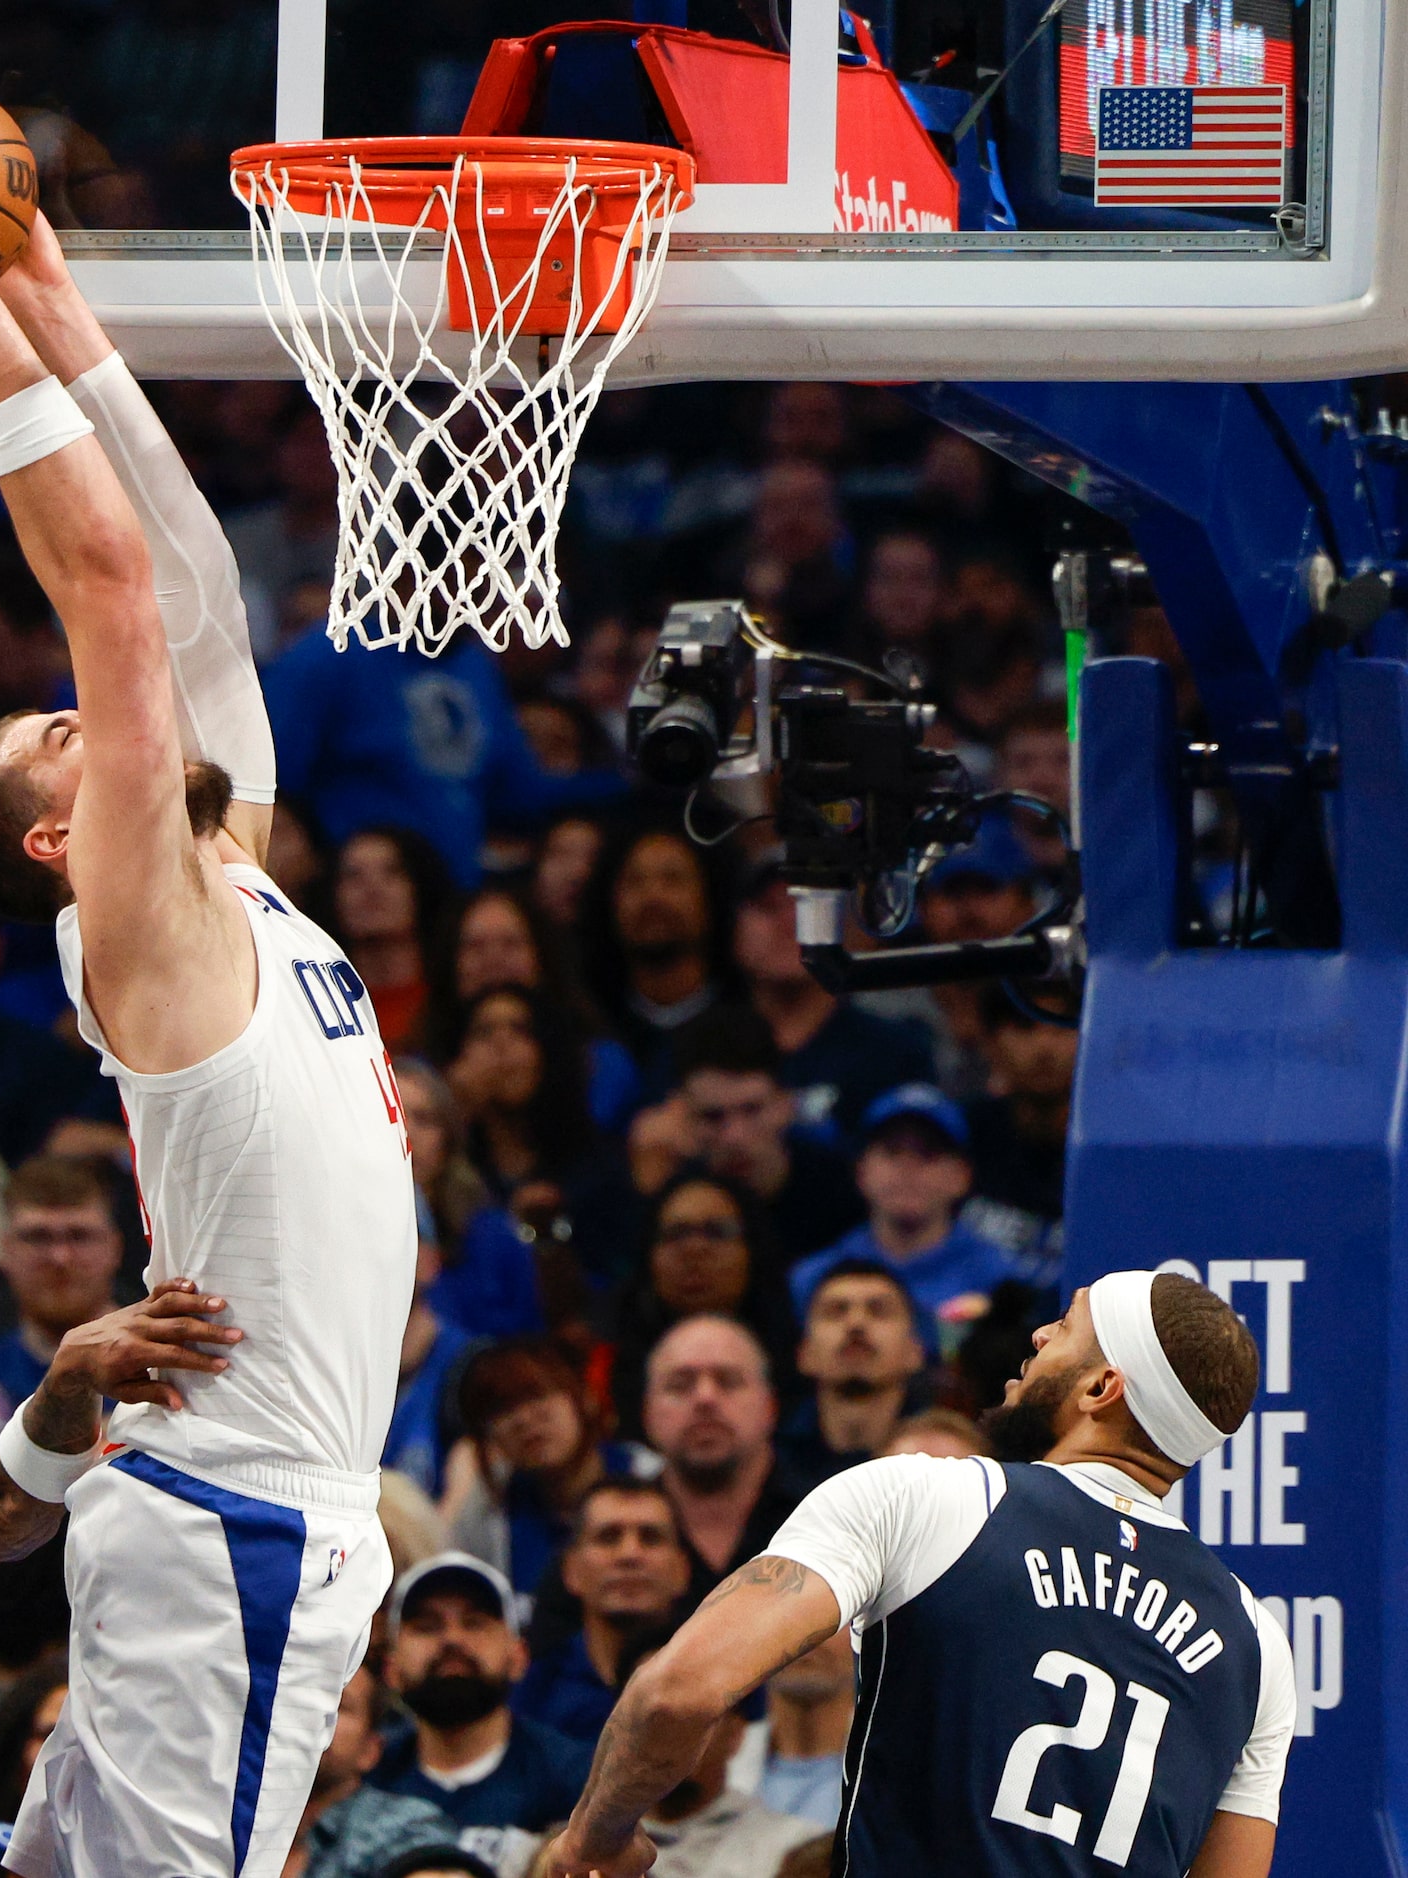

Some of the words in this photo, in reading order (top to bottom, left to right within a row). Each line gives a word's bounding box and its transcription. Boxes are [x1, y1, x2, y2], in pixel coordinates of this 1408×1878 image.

[1163, 1410, 1308, 1546] HE
[1023, 1546, 1225, 1675] GAFFORD
[990, 1649, 1171, 1869] 21
